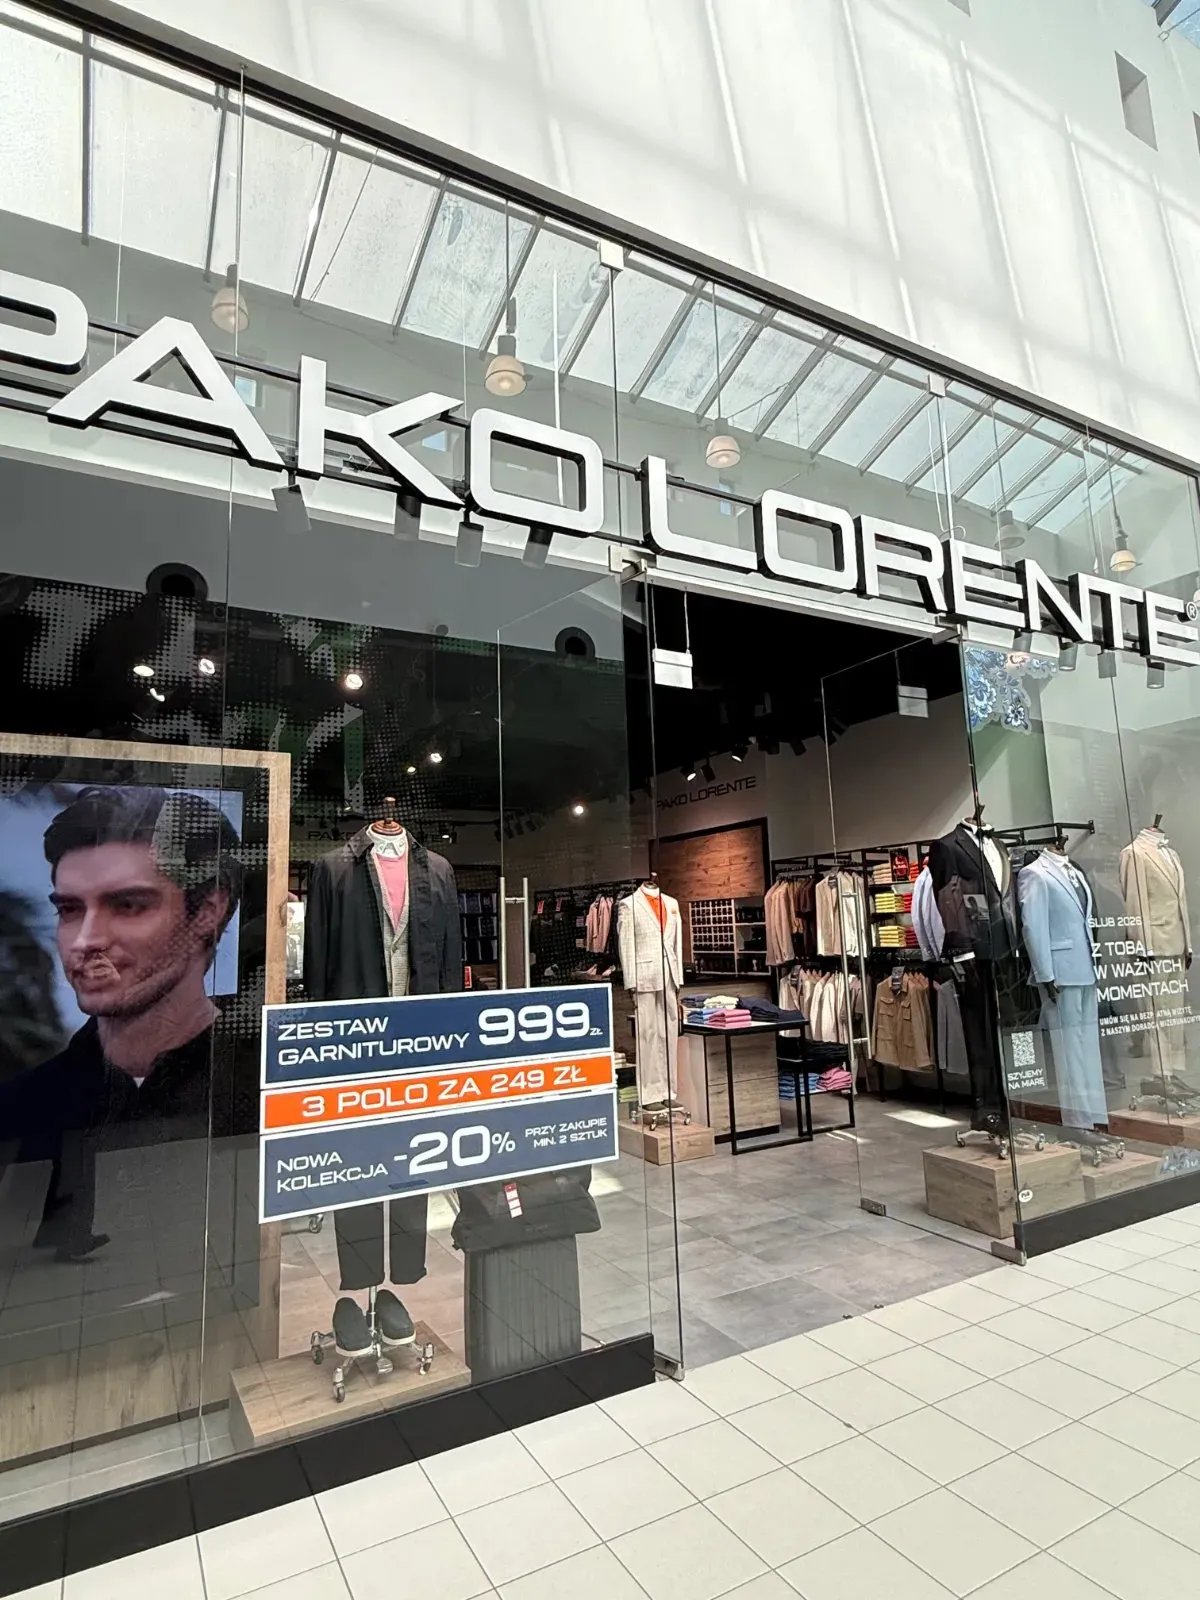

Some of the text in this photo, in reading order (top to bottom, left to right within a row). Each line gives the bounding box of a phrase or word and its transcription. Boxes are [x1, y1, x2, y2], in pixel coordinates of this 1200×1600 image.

[657, 776, 756, 810] PAKO LORENTE
[1117, 916, 1142, 927] 2026
[1091, 942, 1102, 957] Z
[1093, 958, 1182, 980] W WAŻNYCH
[1096, 979, 1189, 1002] MOMENTACH
[478, 1002, 590, 1046] 999
[1139, 1009, 1172, 1021] BEZPATNĄ
[278, 1017, 388, 1041] ZESTAW
[278, 1032, 470, 1066] GARNITUROWY
[1007, 1068, 1043, 1082] SZYJEMY
[1008, 1077, 1045, 1091] NA MIARĘ
[302, 1064, 587, 1117] 3 POLO ZA 249 ZŁ
[525, 1117, 607, 1137] PRZY ZAKUPIE
[533, 1128, 607, 1148] MIN. 2 SZTUK
[394, 1125, 516, 1176] -20%
[277, 1151, 343, 1173] NOWA
[277, 1163, 388, 1194] KOLEKCJA
